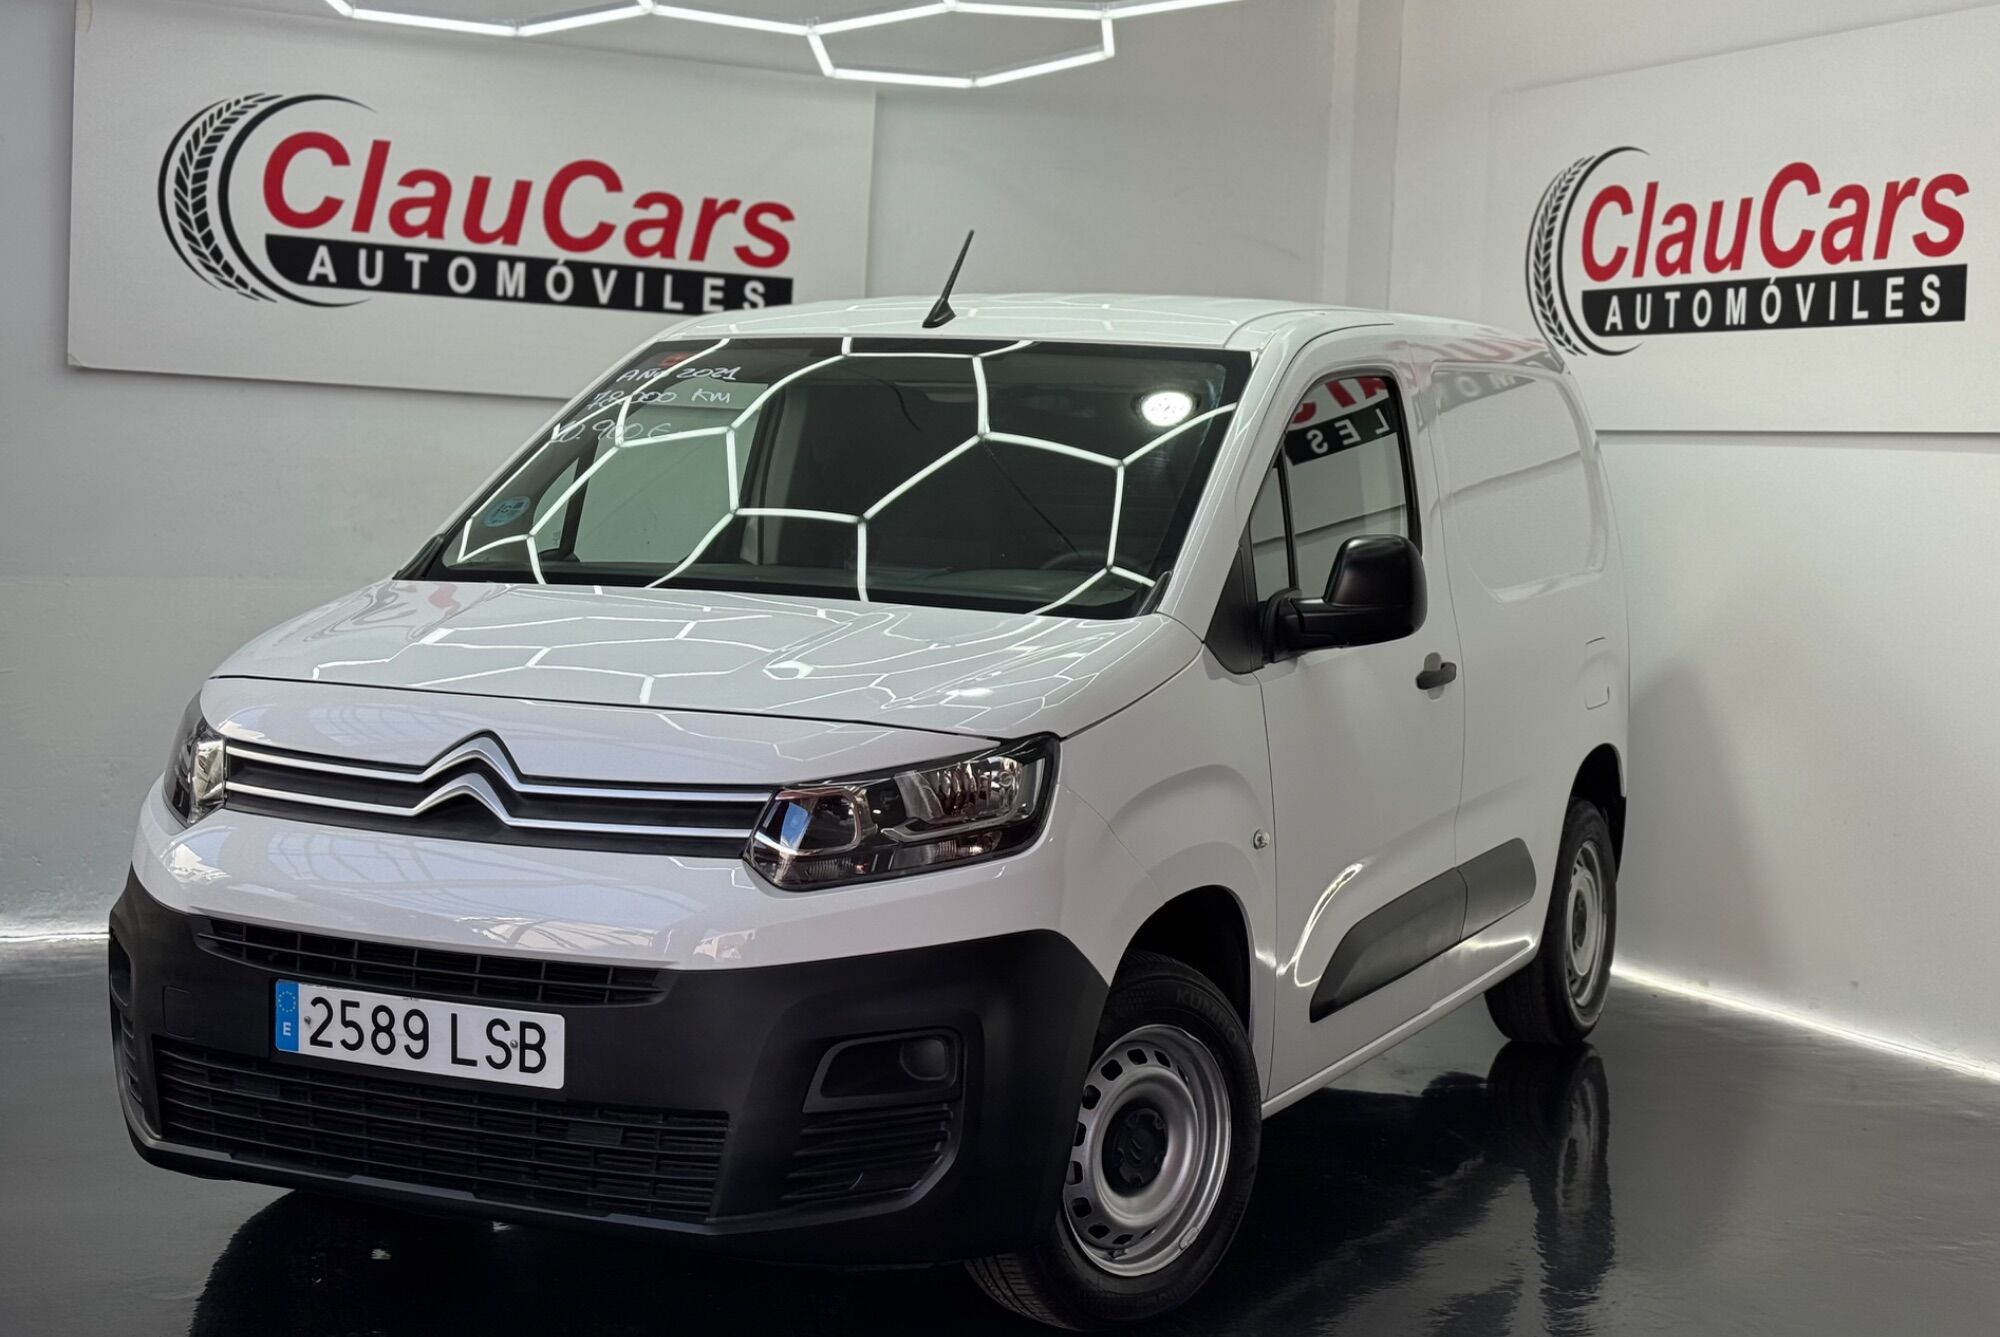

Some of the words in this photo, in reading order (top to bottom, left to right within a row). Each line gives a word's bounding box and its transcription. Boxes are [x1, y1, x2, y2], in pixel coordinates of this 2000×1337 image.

[262, 131, 796, 268] ClauCars
[1581, 162, 1970, 282] ClauCars
[308, 245, 766, 312] AUTOMÓVILES
[1604, 274, 1941, 332] AUTOMÓVILES
[676, 366, 741, 380] 2021
[283, 1022, 292, 1036] E
[309, 996, 430, 1060] 2589
[450, 1012, 547, 1074] LSB
